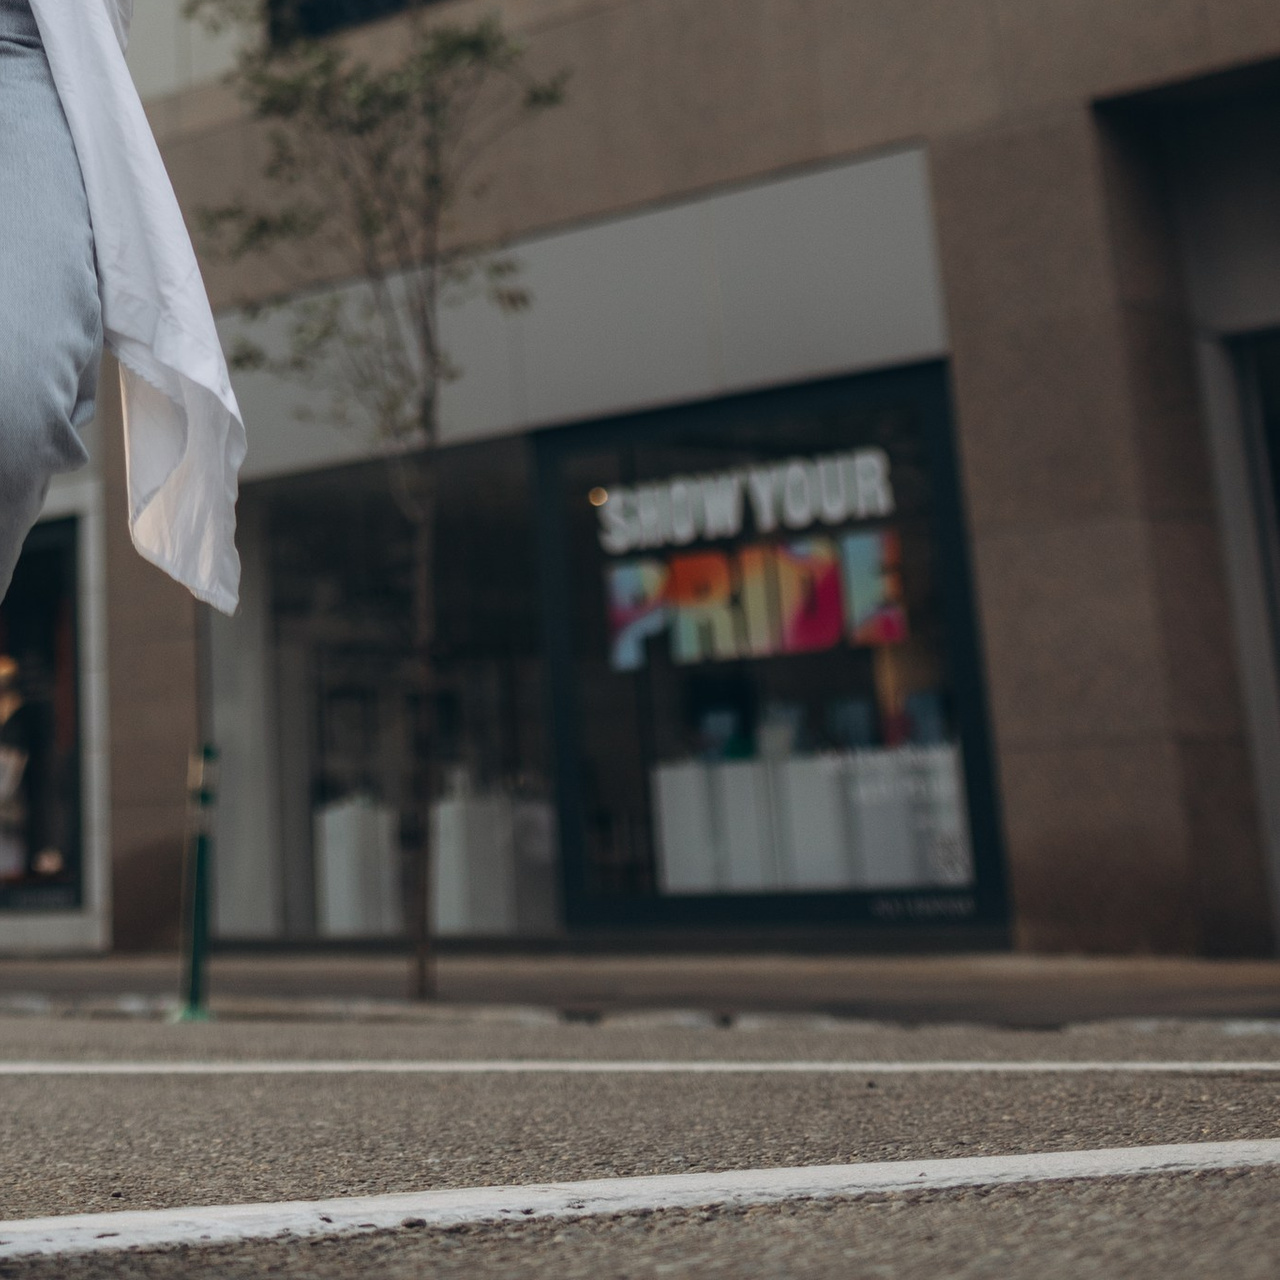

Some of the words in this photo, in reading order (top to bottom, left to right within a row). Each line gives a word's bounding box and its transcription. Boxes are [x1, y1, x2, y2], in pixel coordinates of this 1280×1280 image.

[600, 472, 742, 554] SHOW
[748, 448, 894, 532] YOUR
[607, 530, 908, 671] PRIDE
